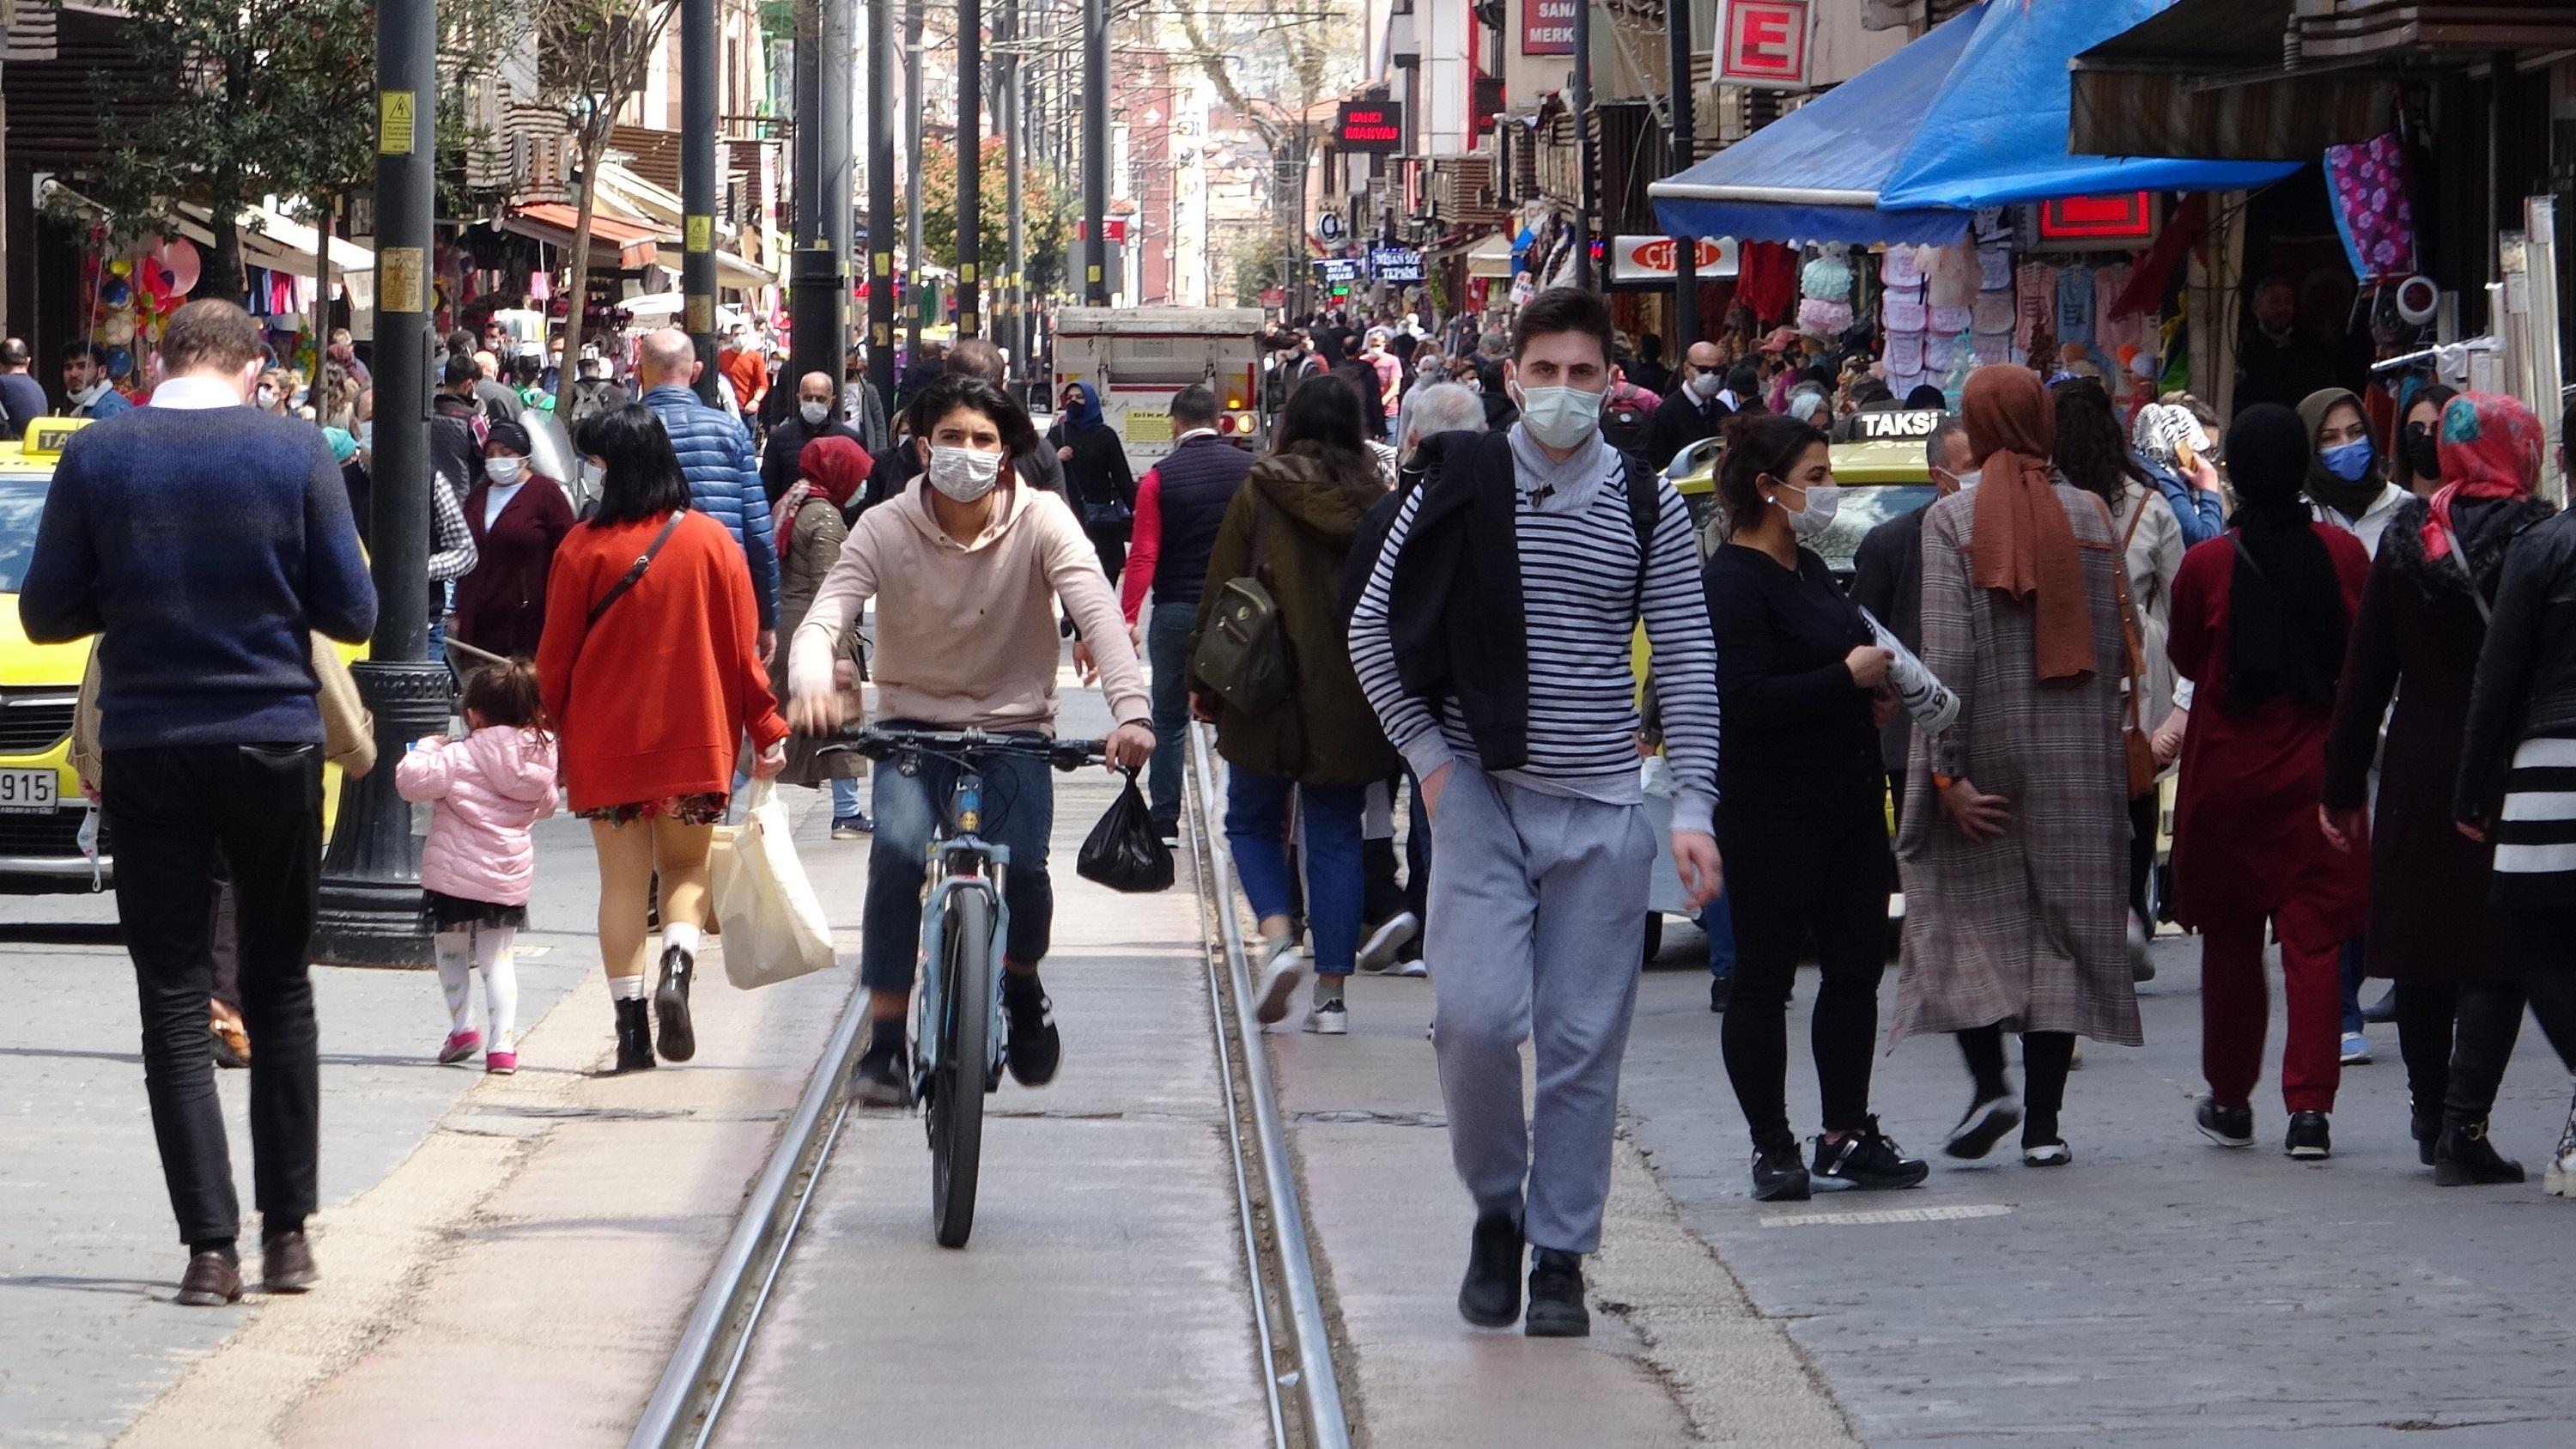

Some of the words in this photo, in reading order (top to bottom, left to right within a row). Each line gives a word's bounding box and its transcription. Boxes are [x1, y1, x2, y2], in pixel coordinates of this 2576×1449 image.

[1741, 10, 1789, 69] E
[1645, 241, 1707, 270] Çifel
[3, 774, 48, 801] 915
